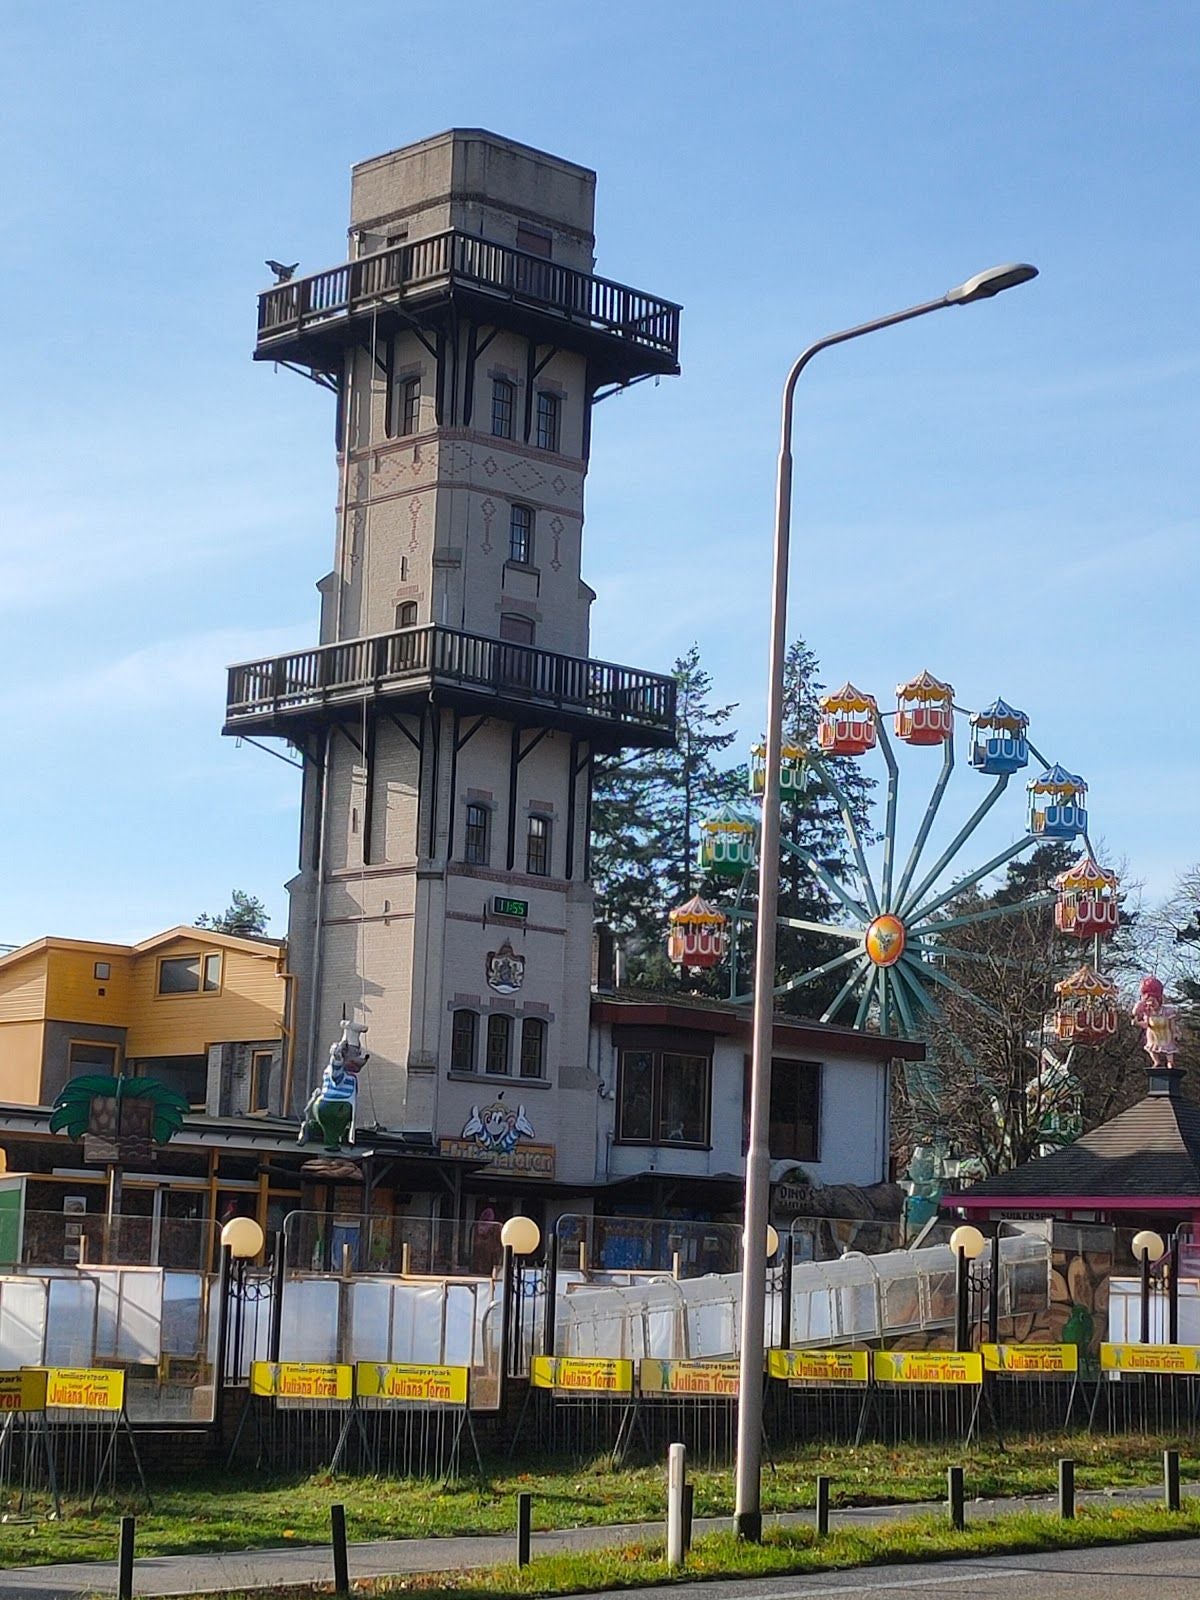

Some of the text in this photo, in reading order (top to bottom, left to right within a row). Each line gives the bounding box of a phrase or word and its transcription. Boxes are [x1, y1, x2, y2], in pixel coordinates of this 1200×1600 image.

[797, 1361, 853, 1377] Juliana Toren
[1008, 1354, 1063, 1369] Juliana Toren
[1128, 1354, 1185, 1368] Juliana Toren
[560, 1369, 616, 1388] Juliana Toren
[905, 1363, 966, 1380] Juliana Toren
[280, 1376, 337, 1396] Juliana Toren
[388, 1377, 450, 1398] Juliana Toren
[671, 1371, 740, 1393] Juliana Toren
[0, 1393, 21, 1409] ren
[50, 1383, 108, 1406] Juliana Toren
